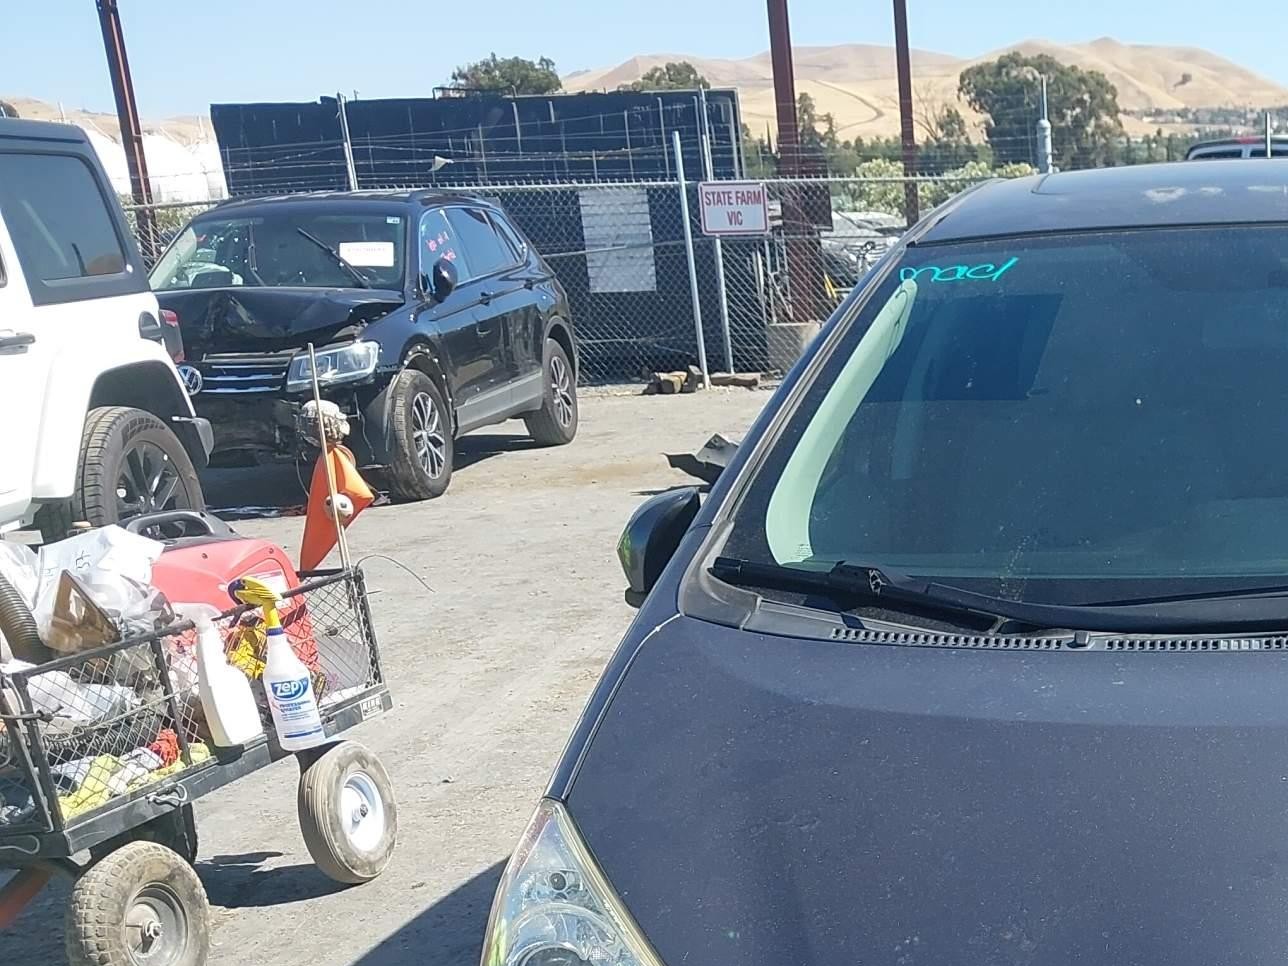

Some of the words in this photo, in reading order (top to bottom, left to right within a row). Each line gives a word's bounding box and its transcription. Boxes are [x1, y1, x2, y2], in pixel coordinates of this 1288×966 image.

[704, 191, 733, 206] STATE
[735, 190, 762, 205] FARM
[727, 210, 743, 226] VIC
